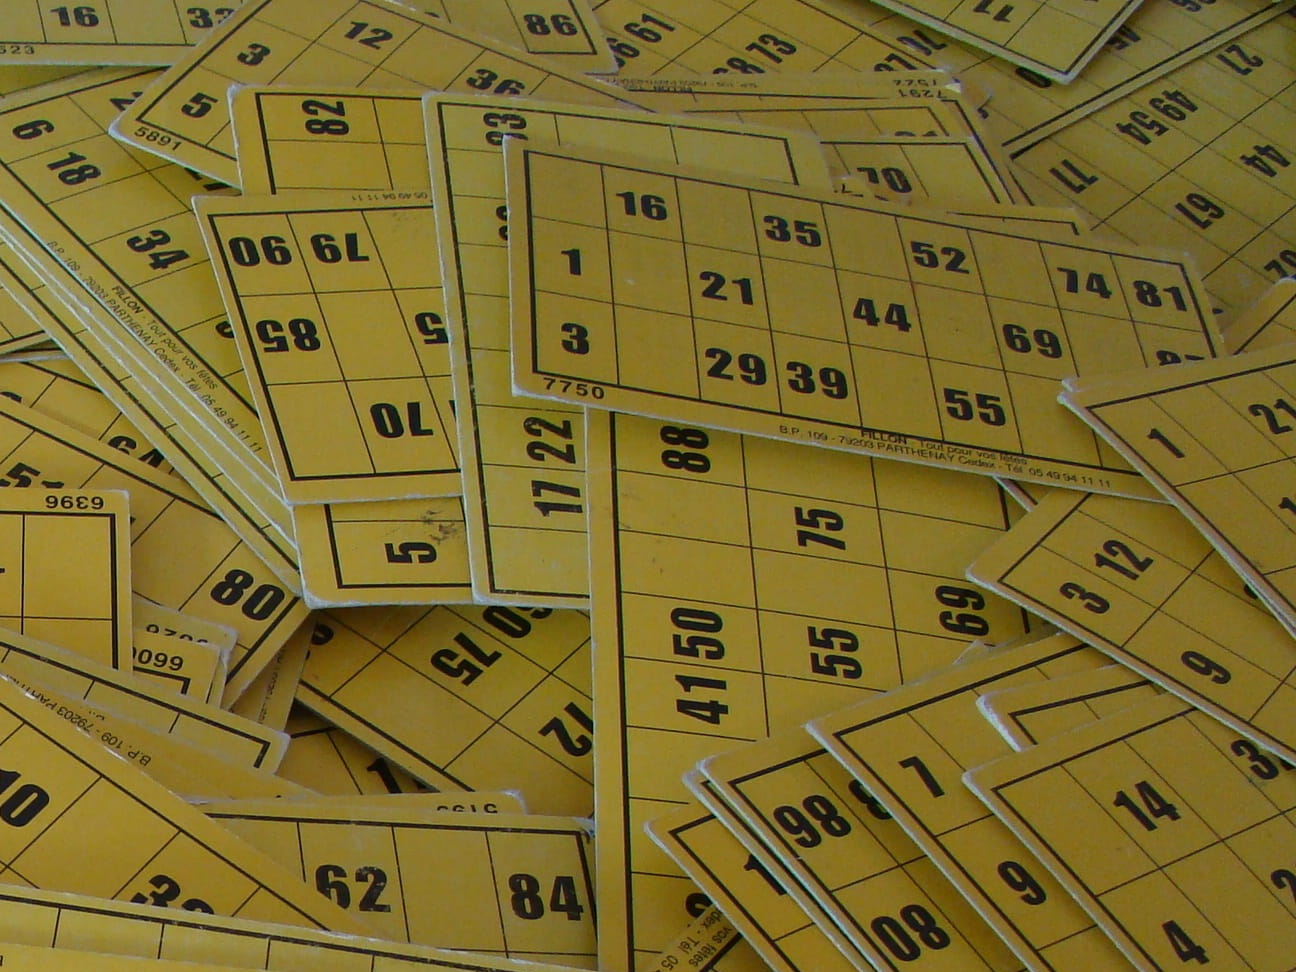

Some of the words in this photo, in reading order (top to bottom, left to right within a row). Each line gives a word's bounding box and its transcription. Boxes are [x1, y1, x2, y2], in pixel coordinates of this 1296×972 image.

[51, 5, 100, 27] 16
[523, 13, 578, 36] 86
[345, 21, 394, 50] 12
[301, 99, 350, 136] 82
[134, 126, 182, 152] 5891
[47, 151, 102, 186] 18
[616, 191, 668, 221] 16
[763, 215, 822, 248] 35
[126, 229, 190, 270] 34
[228, 235, 293, 267] 90
[112, 286, 143, 315] FILLON
[1057, 267, 1113, 299] 74
[1133, 280, 1188, 312] 81
[853, 297, 913, 333] 44
[561, 322, 590, 355] 3
[542, 376, 606, 400] 7750
[786, 361, 849, 400] 39
[369, 401, 434, 439] 70
[860, 429, 907, 444] FILLON
[877, 442, 954, 462] PARTHENAY
[958, 456, 995, 469] Cedex
[45, 495, 104, 510] 6396
[531, 479, 584, 517] 17
[794, 506, 847, 551] 75
[1094, 539, 1154, 581] 12
[210, 568, 286, 621] 80
[935, 584, 990, 637] 69
[430, 631, 503, 687] 75
[807, 625, 863, 680] 55
[101, 731, 124, 749] 109
[898, 755, 946, 798] 7
[1113, 780, 1182, 832] 14
[508, 873, 585, 922] 84
[870, 904, 951, 962] 80
